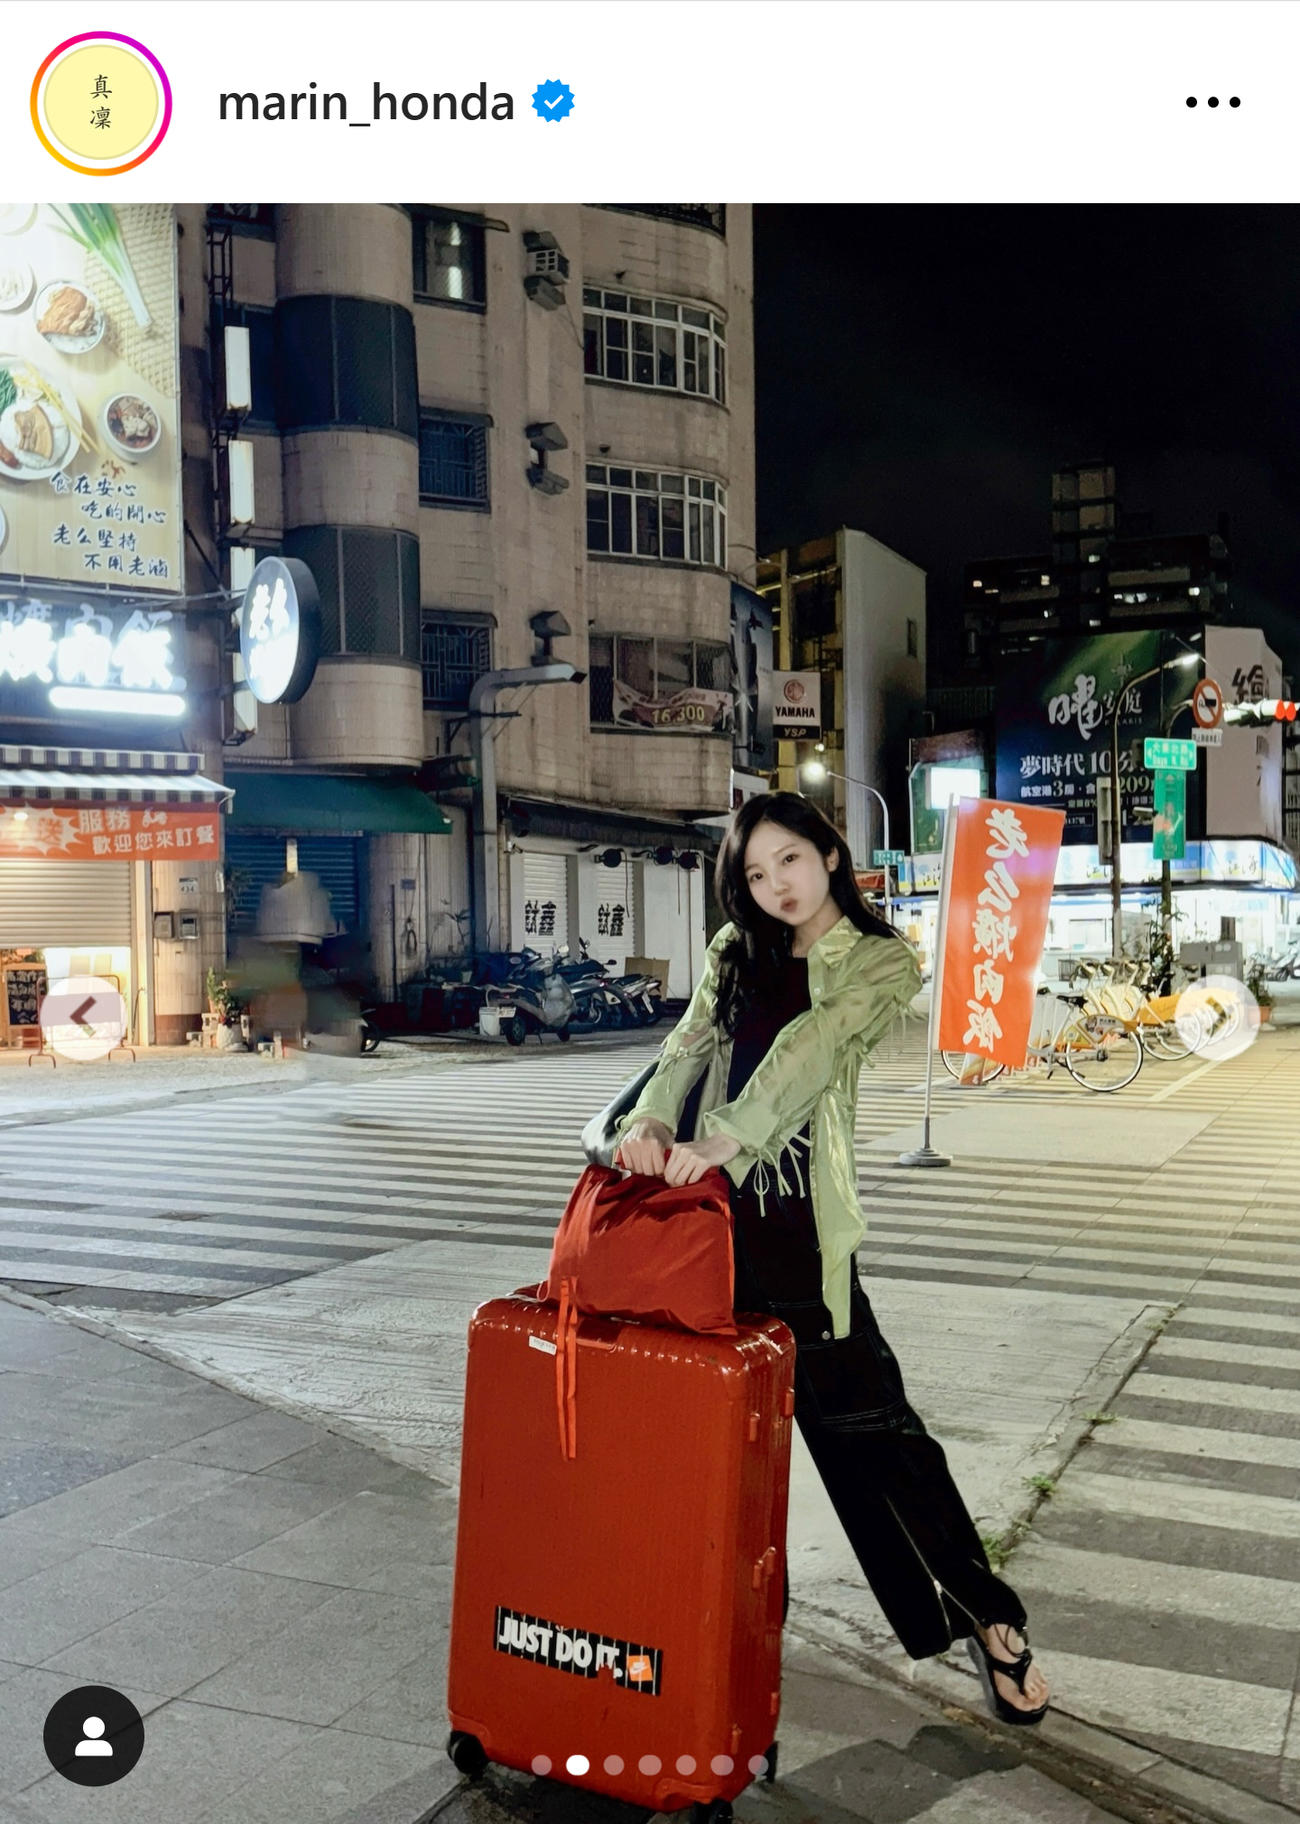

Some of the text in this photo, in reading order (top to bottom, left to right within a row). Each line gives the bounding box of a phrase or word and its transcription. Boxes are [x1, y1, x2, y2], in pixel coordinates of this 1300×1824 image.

[51, 472, 137, 498] 食在安心
[81, 500, 167, 524] 吃的開心
[775, 705, 816, 719] YAMAHA
[784, 727, 807, 738] YSP
[92, 823, 215, 856] 歡迎您來訂餐
[499, 1616, 624, 1680] JUST DO IT.
